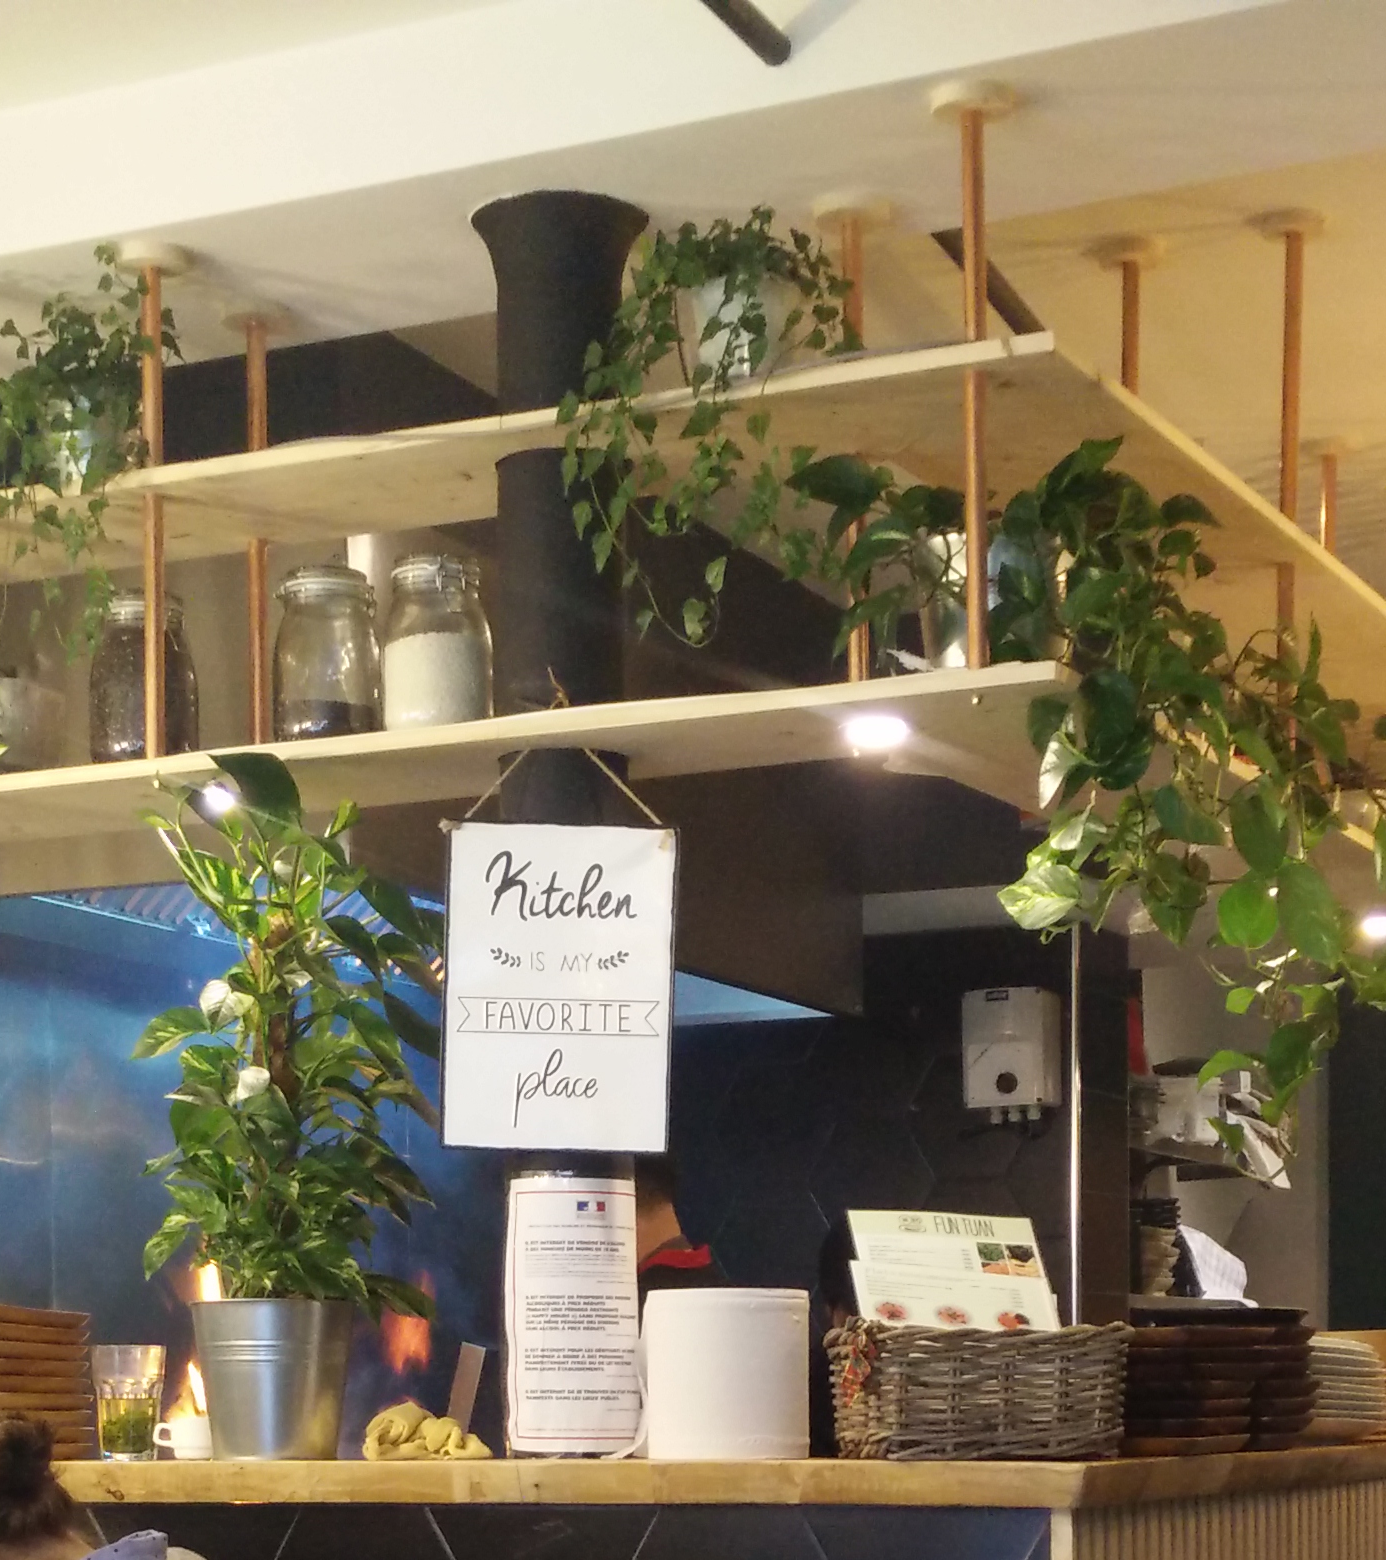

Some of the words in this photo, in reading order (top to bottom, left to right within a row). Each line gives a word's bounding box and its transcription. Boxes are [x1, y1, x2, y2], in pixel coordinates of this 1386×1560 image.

[485, 850, 637, 921] Kitchen
[530, 952, 546, 971] IS
[560, 953, 593, 972] MY
[484, 1001, 631, 1032] FAVORITE
[513, 1048, 598, 1128] place
[933, 1215, 960, 1234] FUN
